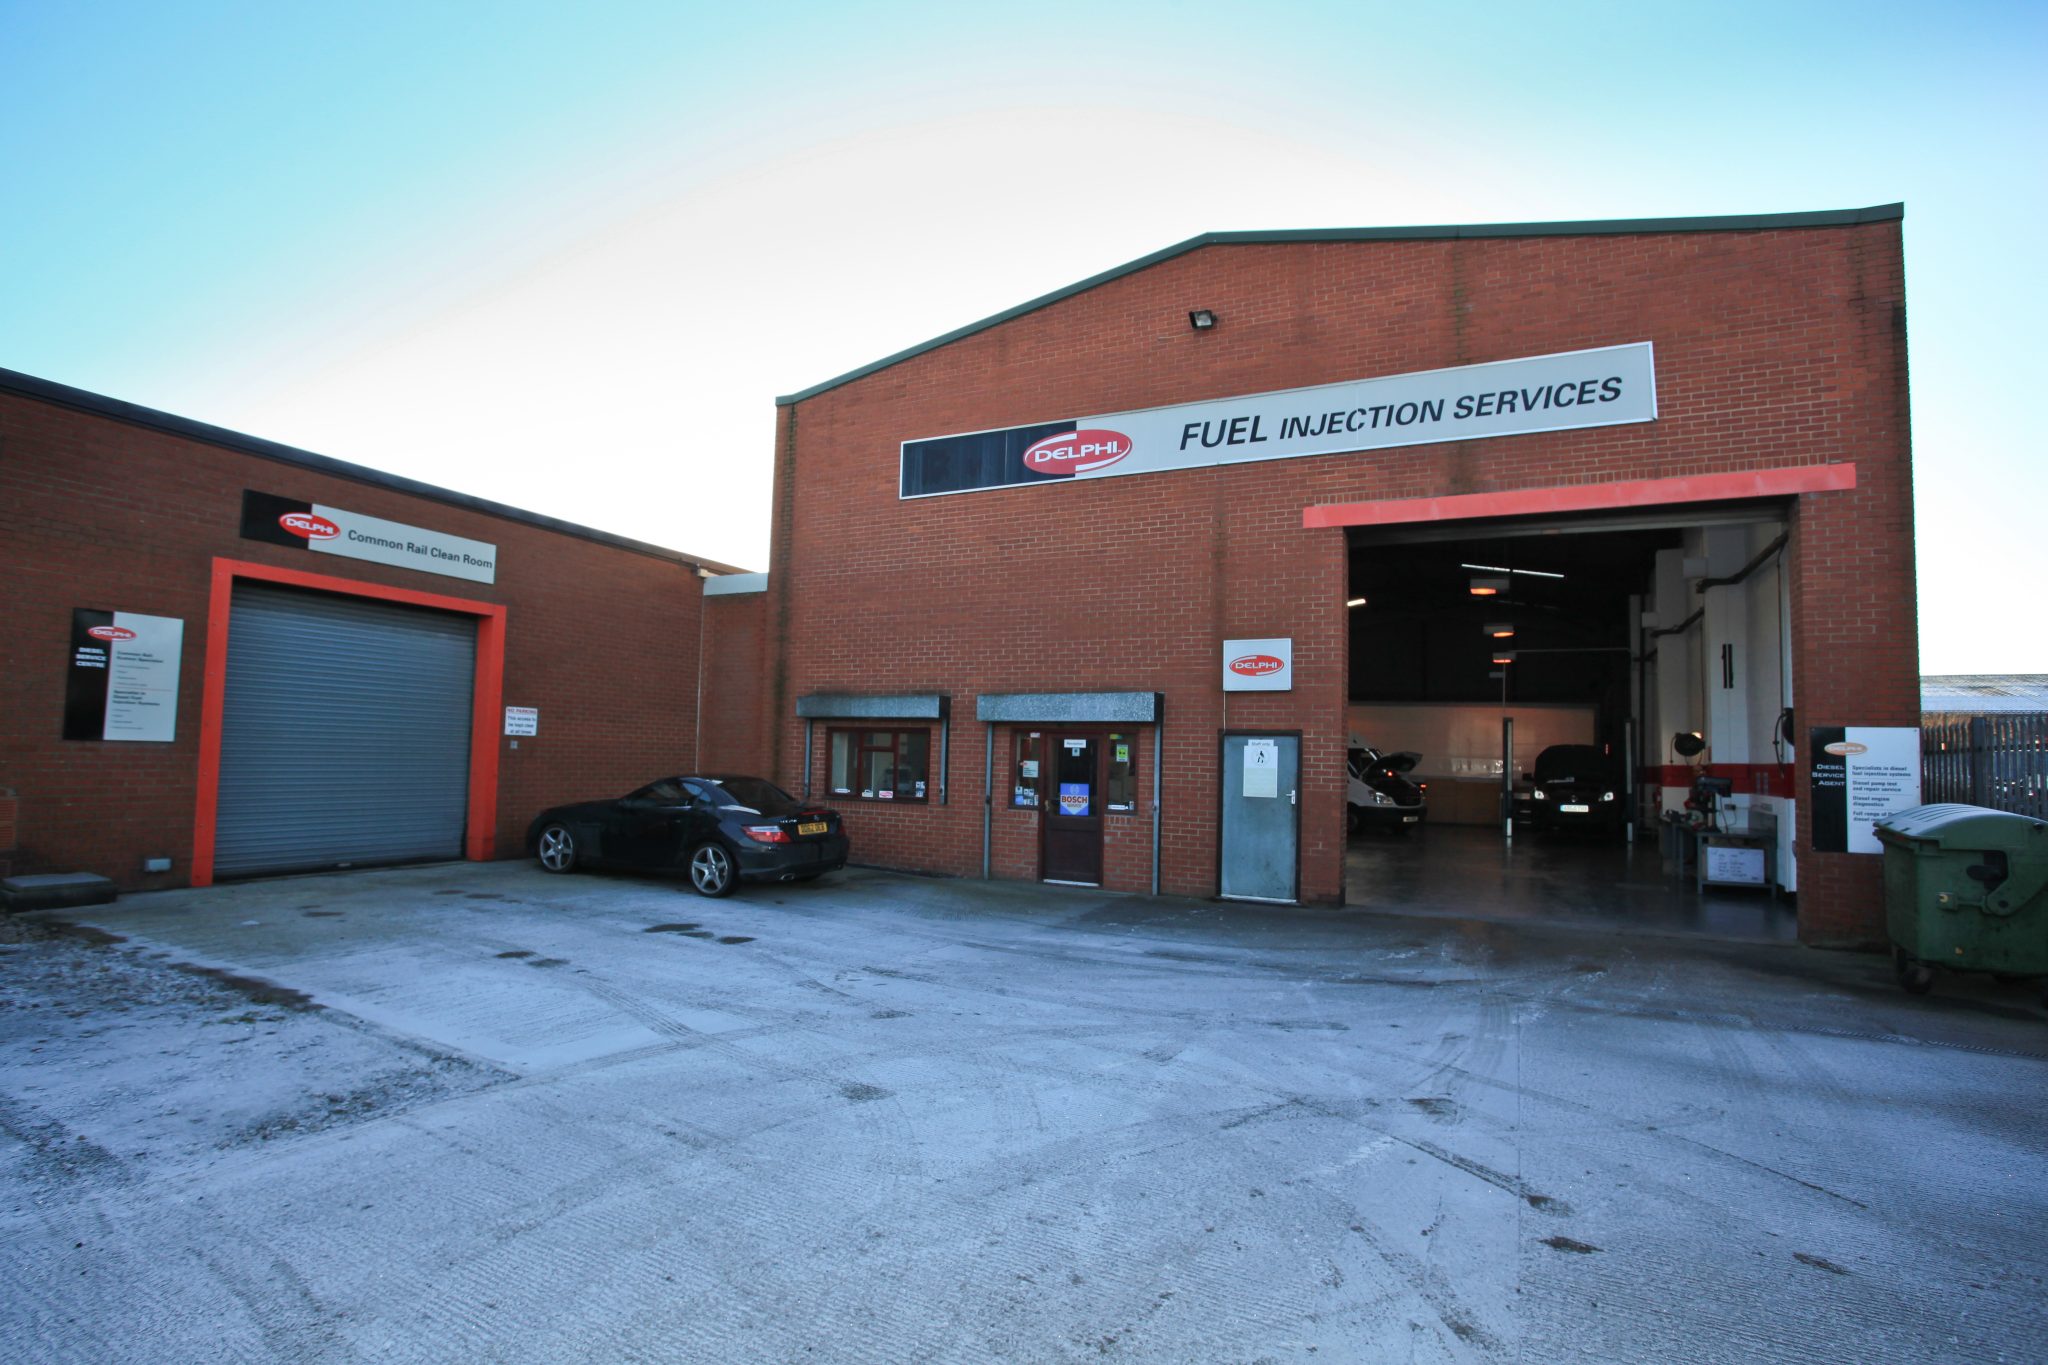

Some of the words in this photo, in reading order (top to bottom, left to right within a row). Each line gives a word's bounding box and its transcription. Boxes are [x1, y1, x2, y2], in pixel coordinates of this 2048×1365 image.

[1034, 441, 1118, 463] DELPHI
[1180, 415, 1268, 451] FUEL
[1279, 399, 1445, 440] INJECTION
[1453, 376, 1623, 420] SERVICES
[286, 518, 334, 534] DELPHI
[348, 529, 403, 551] Common
[406, 542, 428, 556] Rail
[430, 547, 460, 563] Clean
[462, 554, 493, 569] Room
[1235, 661, 1278, 669] DELPHI
[1061, 795, 1088, 804] BOSCH
